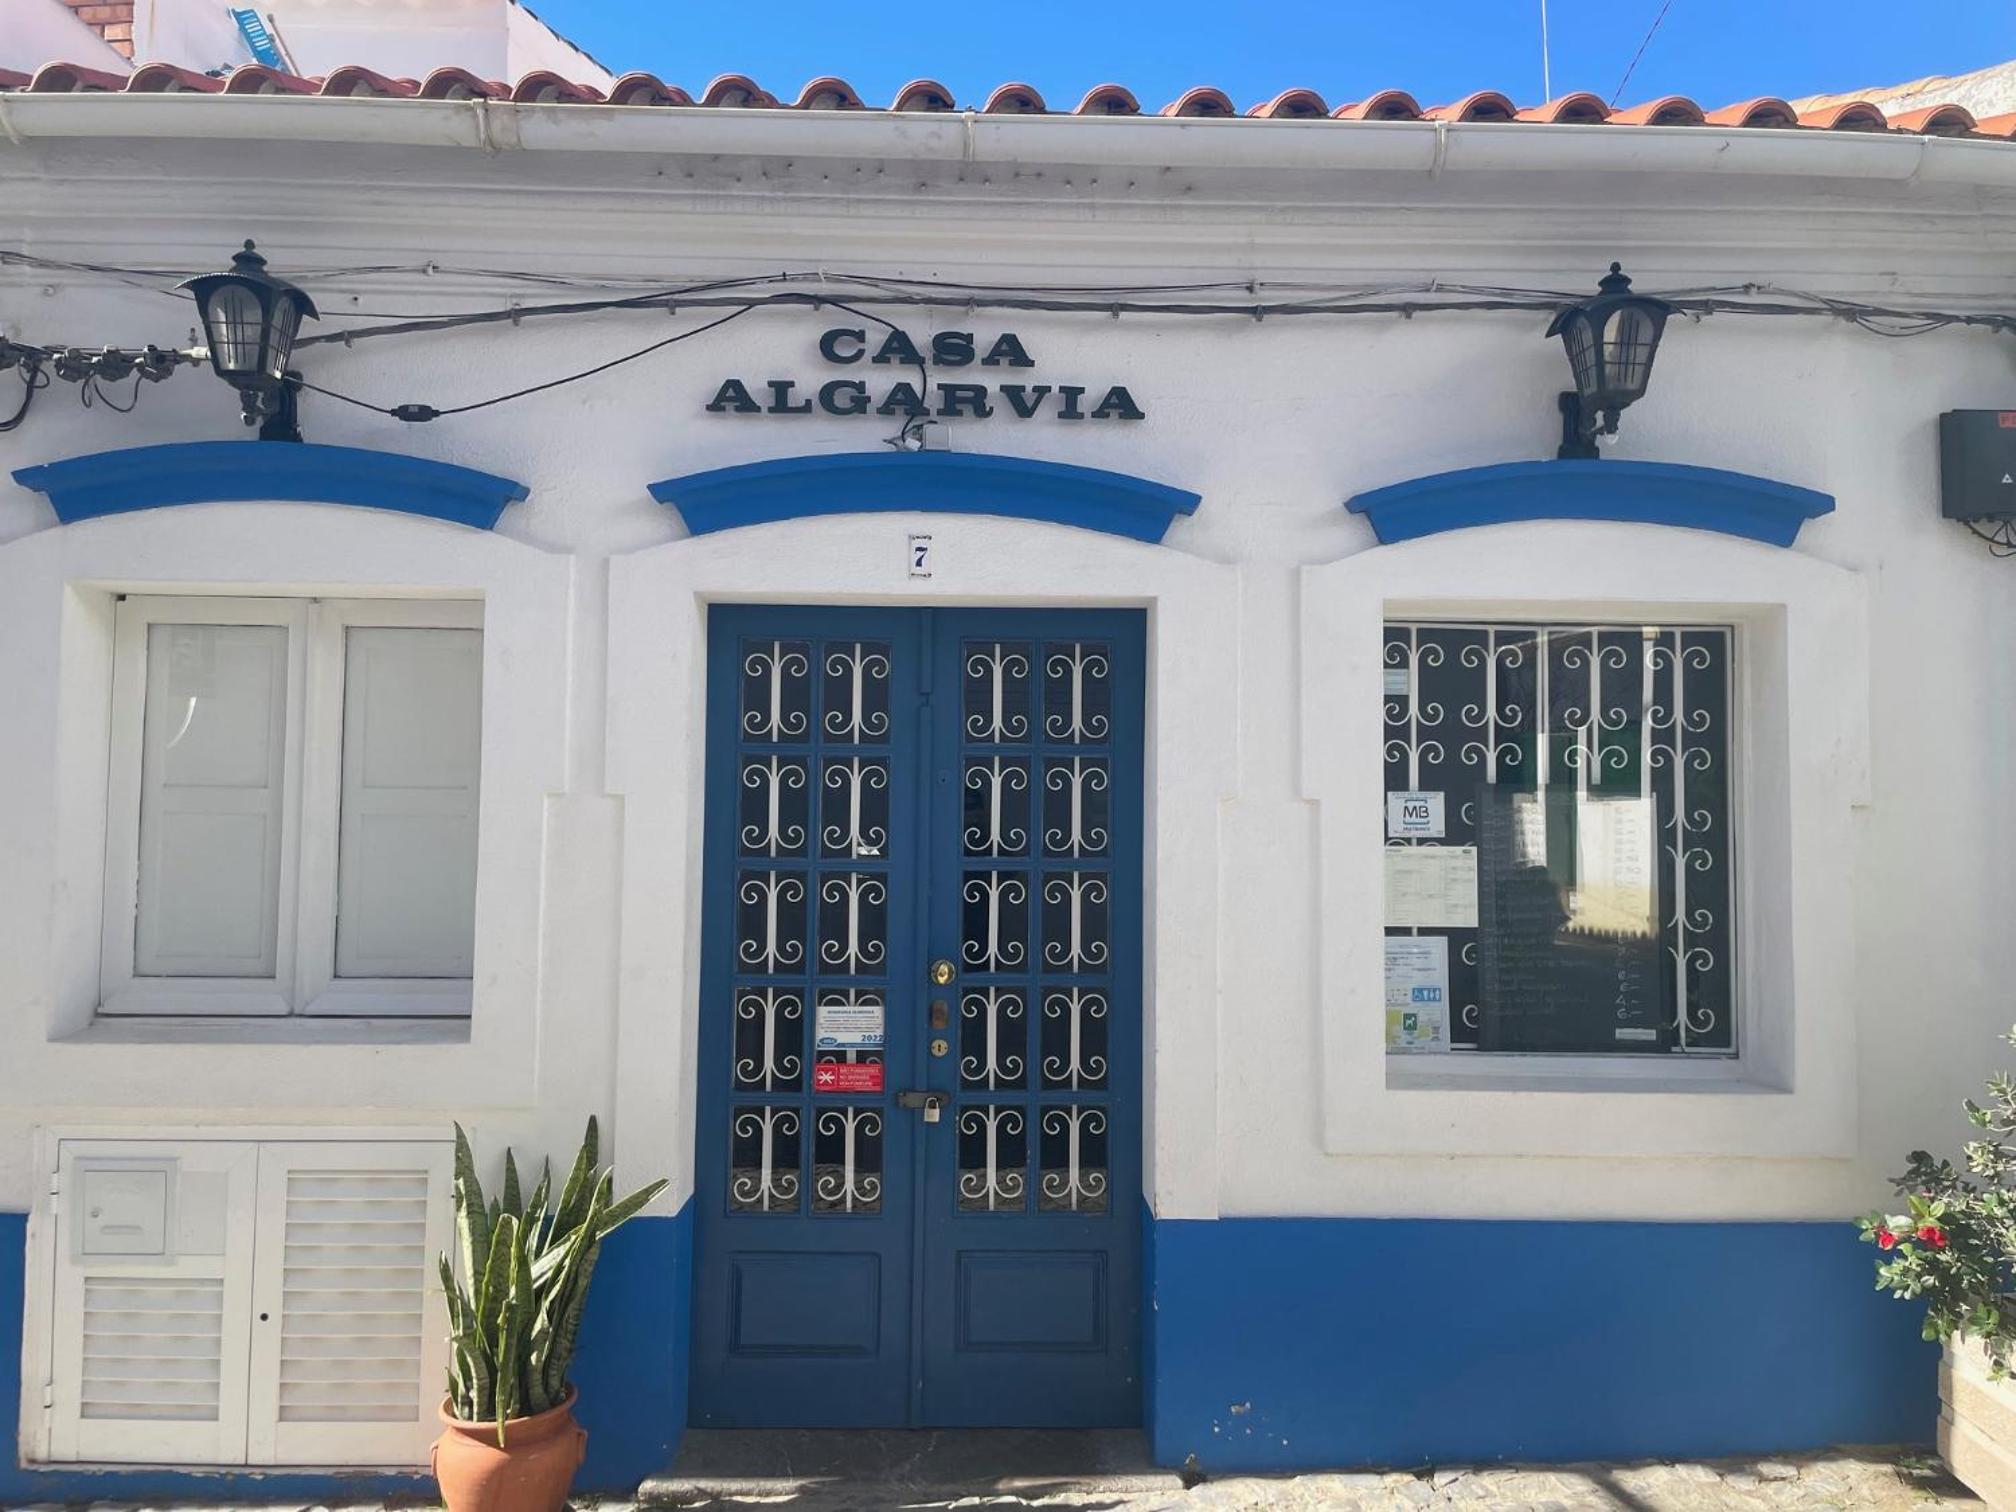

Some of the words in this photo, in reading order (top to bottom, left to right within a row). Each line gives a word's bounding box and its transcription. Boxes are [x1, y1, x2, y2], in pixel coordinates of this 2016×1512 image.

[819, 328, 1035, 368] CASA
[705, 378, 1146, 420] ALGARVIA
[914, 546, 928, 567] 7
[1403, 805, 1430, 819] MB
[861, 1034, 885, 1043] 2022
